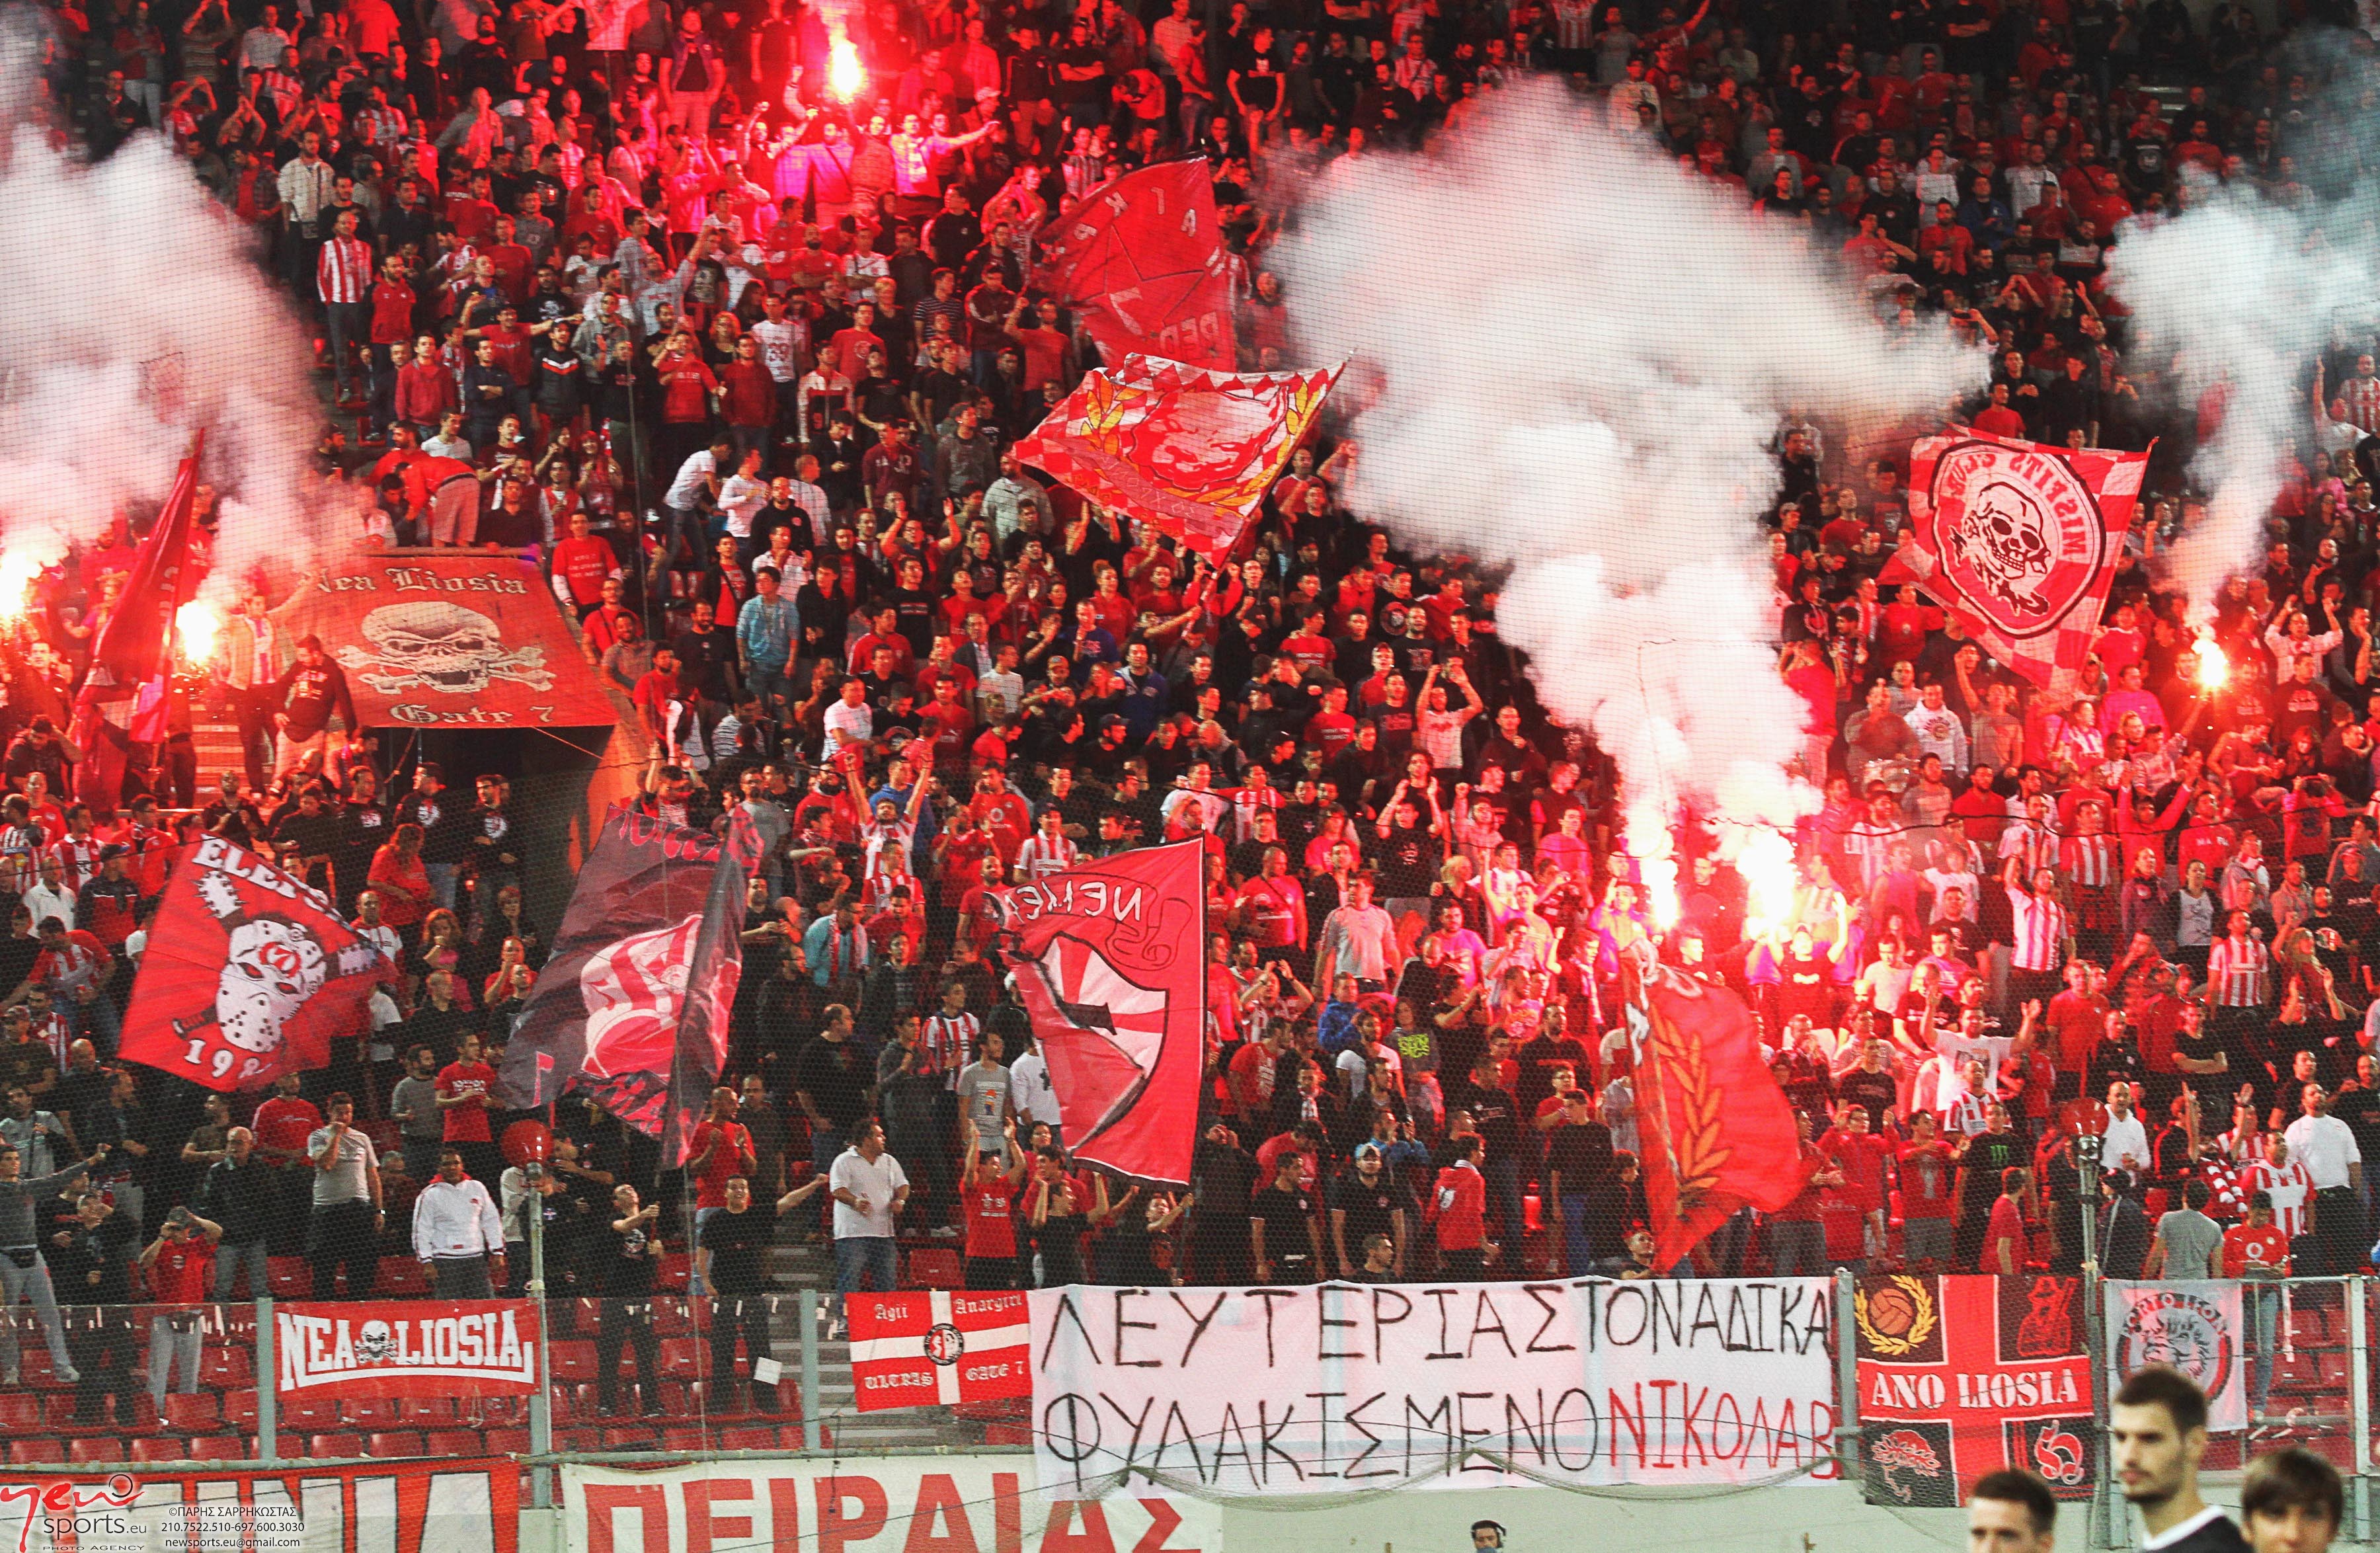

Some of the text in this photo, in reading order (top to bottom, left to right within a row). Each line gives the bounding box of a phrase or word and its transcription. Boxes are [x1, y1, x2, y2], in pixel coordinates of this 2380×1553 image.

[384, 567, 529, 594] Liosia
[389, 703, 555, 725] Gate 7
[874, 1303, 909, 1322] Agii
[278, 1308, 534, 1392] NEA LIOSIA
[863, 1372, 934, 1390] ULTRAS
[965, 1363, 1010, 1382] GATE
[1870, 1367, 2079, 1410] ANO LIOSIA
